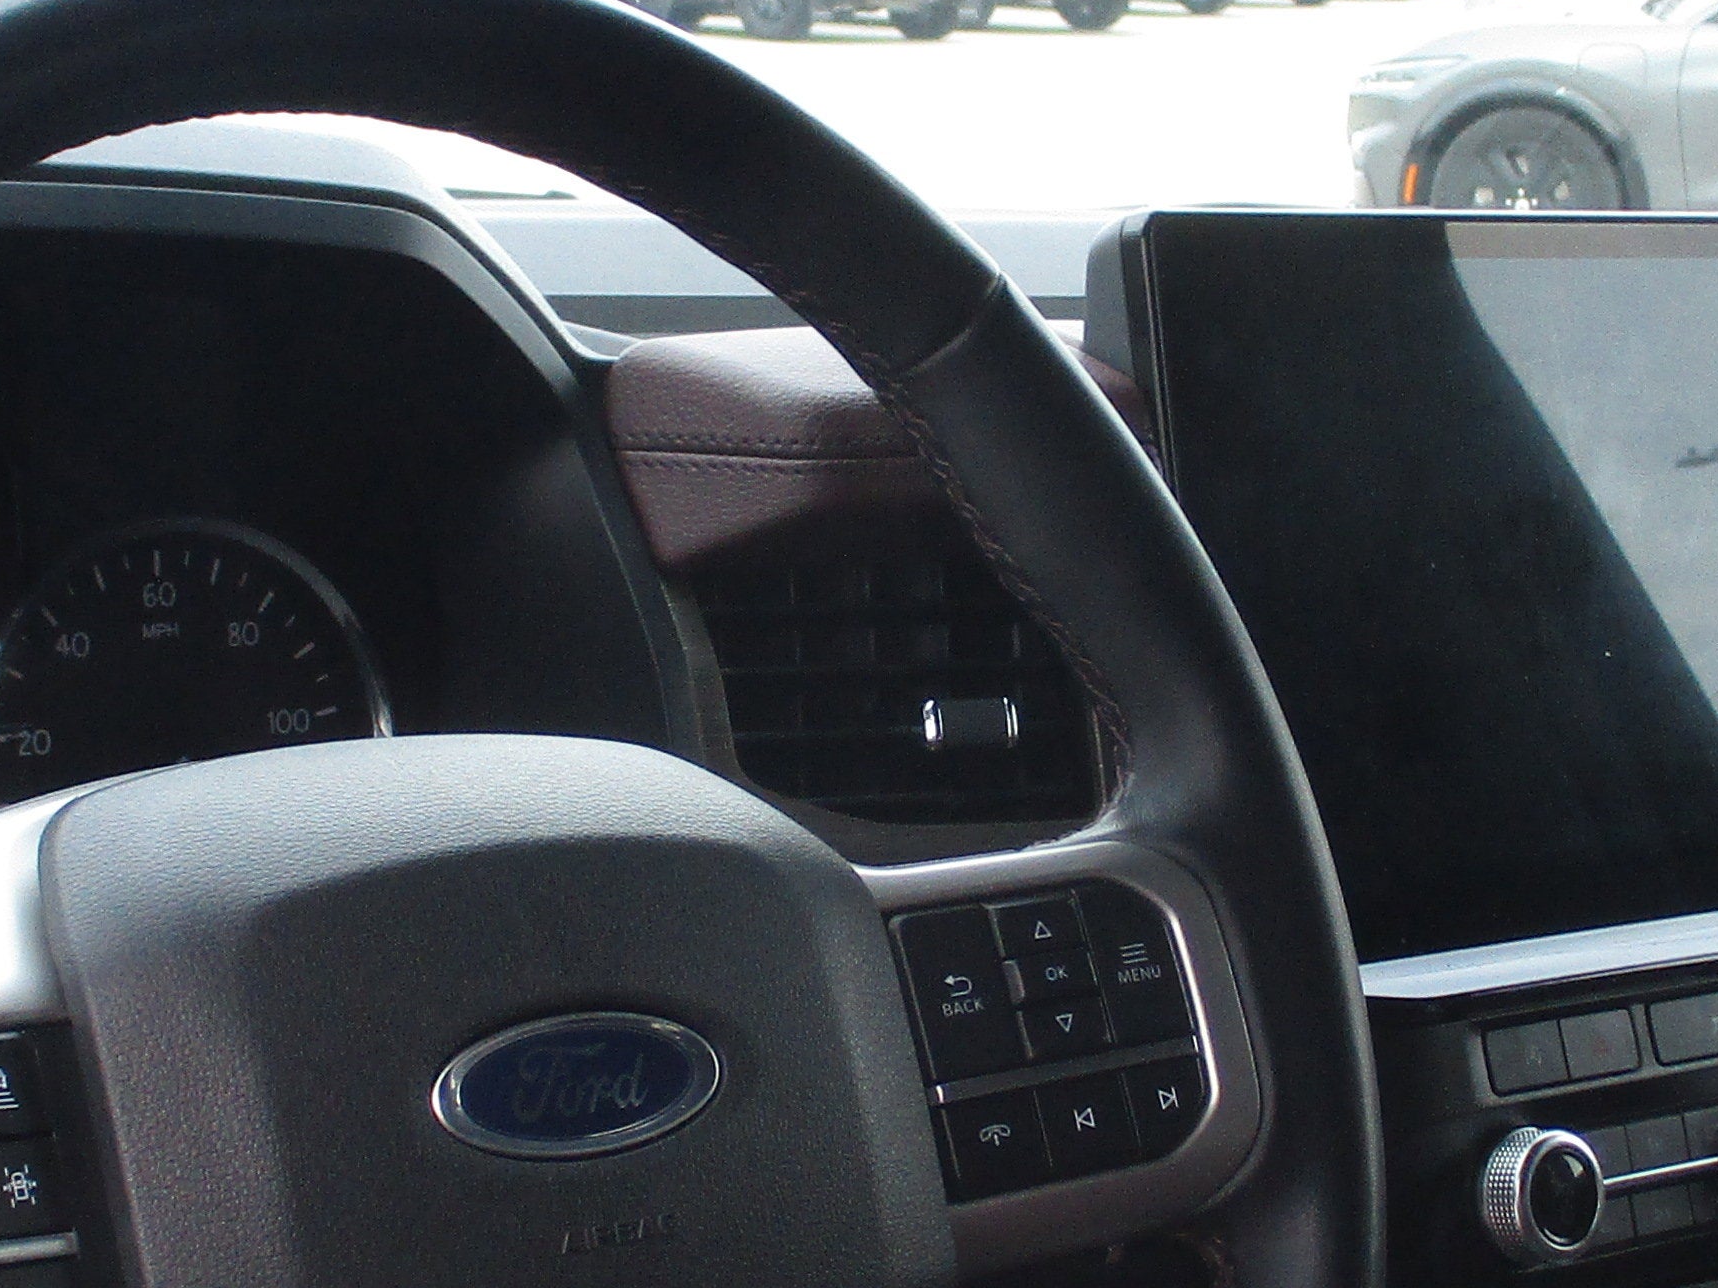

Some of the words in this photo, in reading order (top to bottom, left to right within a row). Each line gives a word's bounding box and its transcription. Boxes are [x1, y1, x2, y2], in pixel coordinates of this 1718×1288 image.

[142, 581, 177, 609] 60
[142, 622, 180, 640] MPH
[228, 621, 259, 648] 80
[55, 632, 91, 659] 40
[268, 708, 310, 735] 100
[18, 729, 52, 757] 20
[1045, 965, 1069, 983] OK
[1117, 965, 1162, 985] MENU
[941, 999, 985, 1018] BACK
[512, 1042, 650, 1124] Ford
